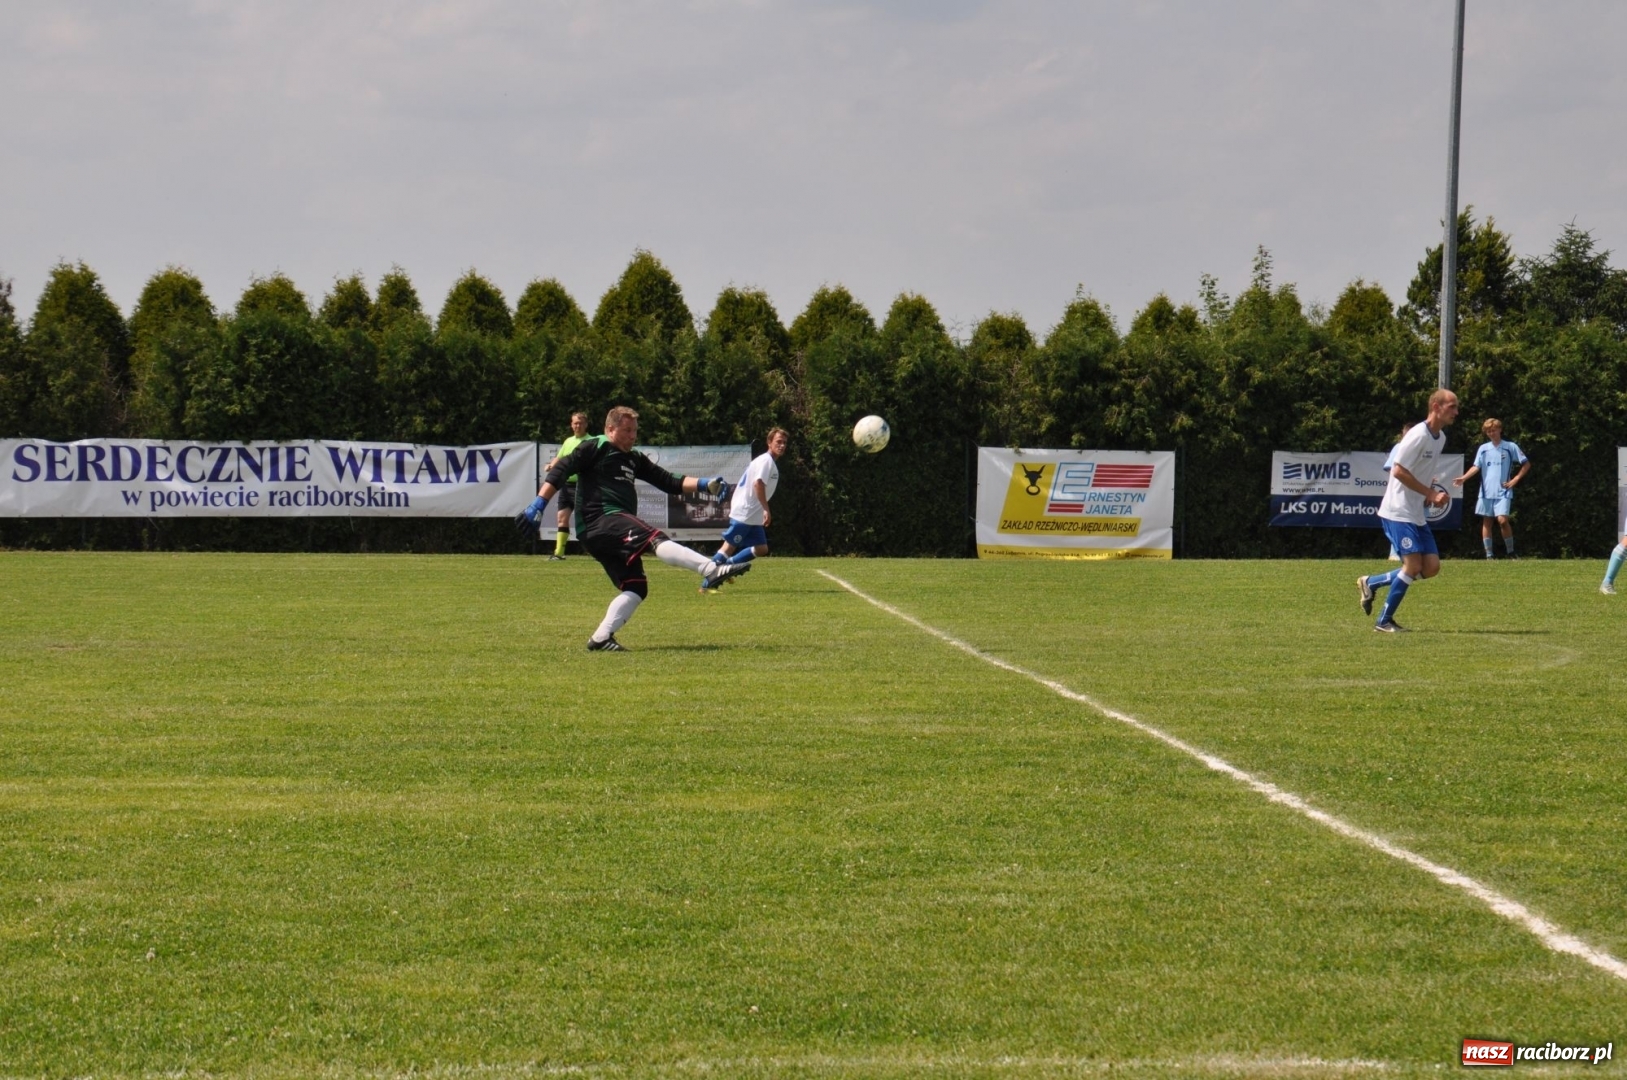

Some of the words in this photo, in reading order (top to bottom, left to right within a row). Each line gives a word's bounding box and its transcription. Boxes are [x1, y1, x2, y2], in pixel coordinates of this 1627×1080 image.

[12, 444, 313, 483] SERDECZNIE
[327, 447, 511, 484] WITAMY
[1304, 463, 1351, 480] WMB
[1354, 477, 1388, 488] Sponso
[121, 490, 143, 506] w
[150, 486, 259, 512] powiecie
[268, 485, 410, 508] raciborskim
[1085, 504, 1133, 515] JANETA
[1280, 501, 1307, 514] LKS
[1311, 501, 1327, 514] 07
[1001, 519, 1034, 531] ZAKŁAD
